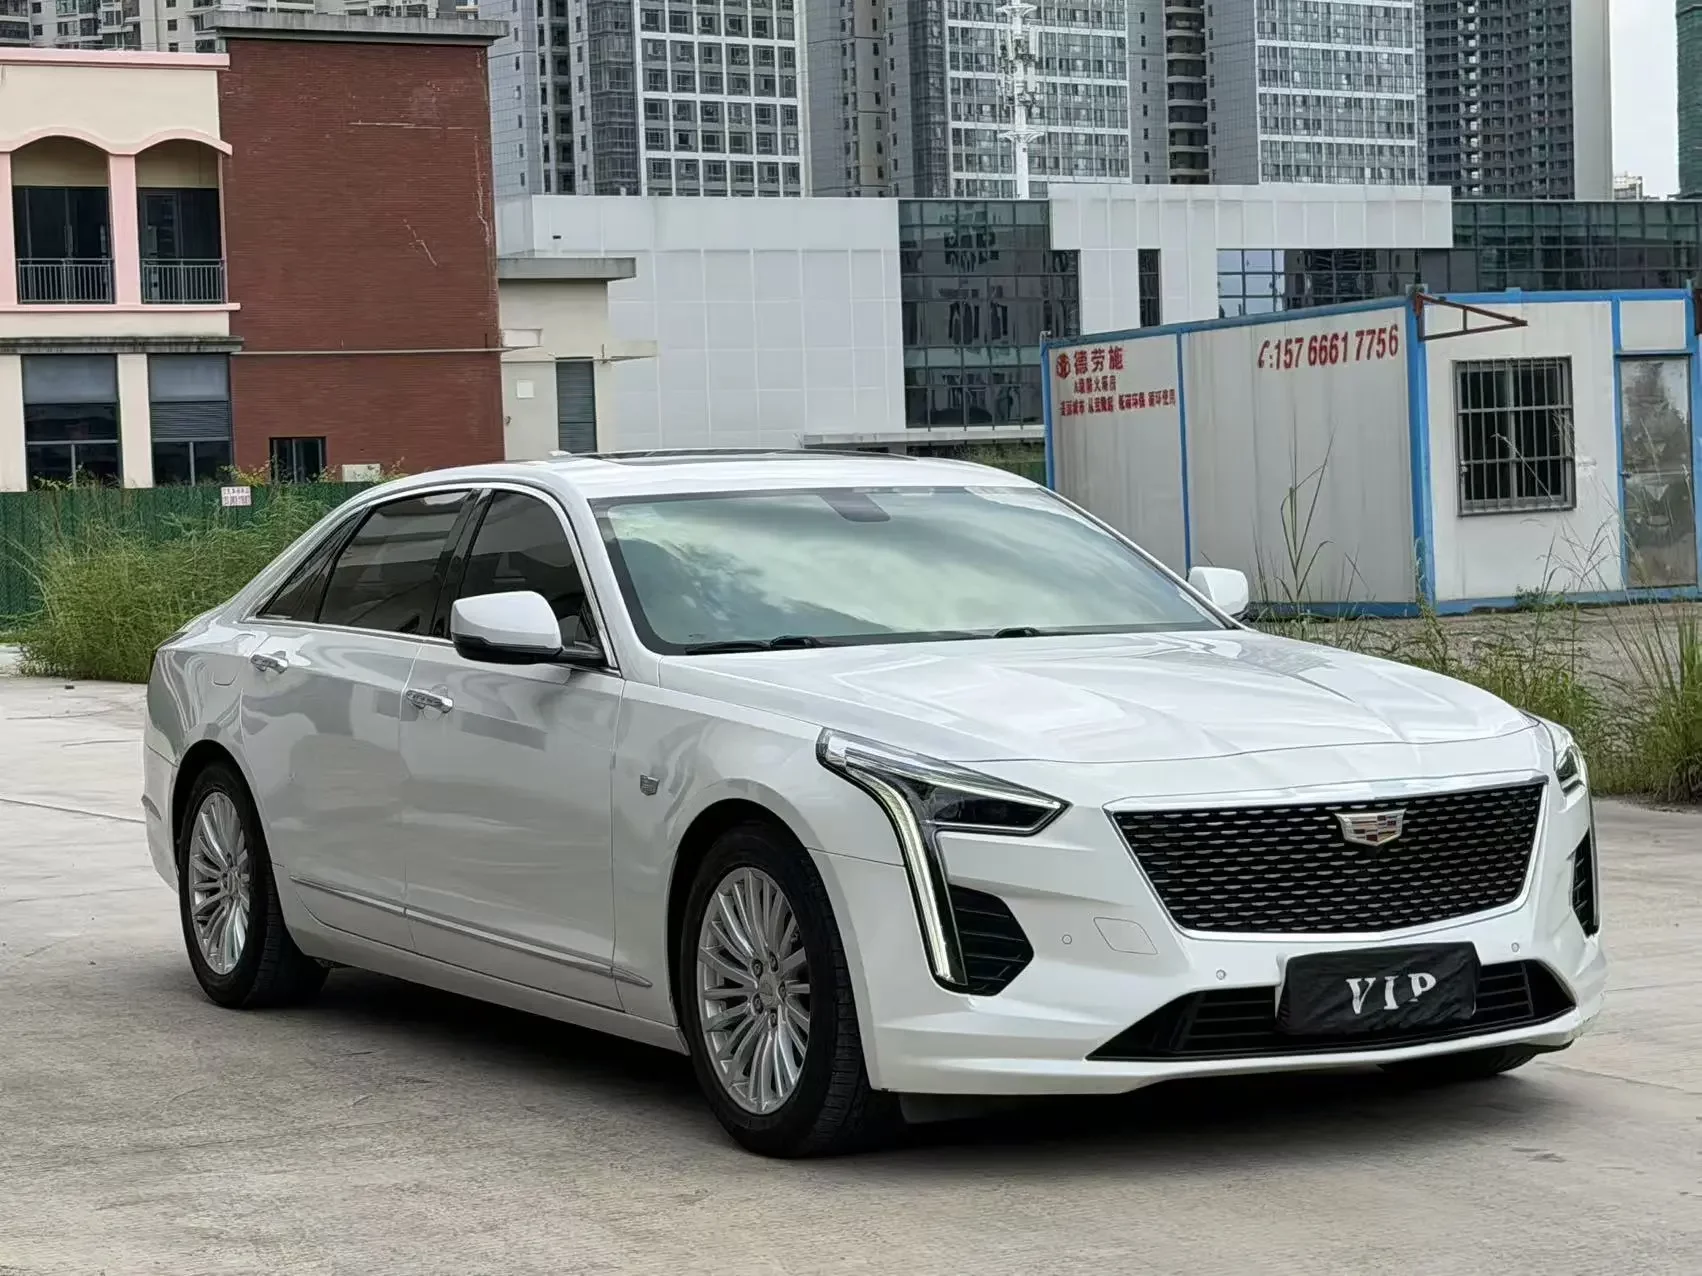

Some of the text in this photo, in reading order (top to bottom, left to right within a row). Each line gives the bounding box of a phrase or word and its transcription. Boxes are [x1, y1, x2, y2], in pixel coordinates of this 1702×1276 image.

[1073, 346, 1124, 375] 德劳施
[1307, 331, 1349, 367] 6661
[1355, 323, 1400, 361] 7756
[1345, 972, 1437, 1015] VIP
